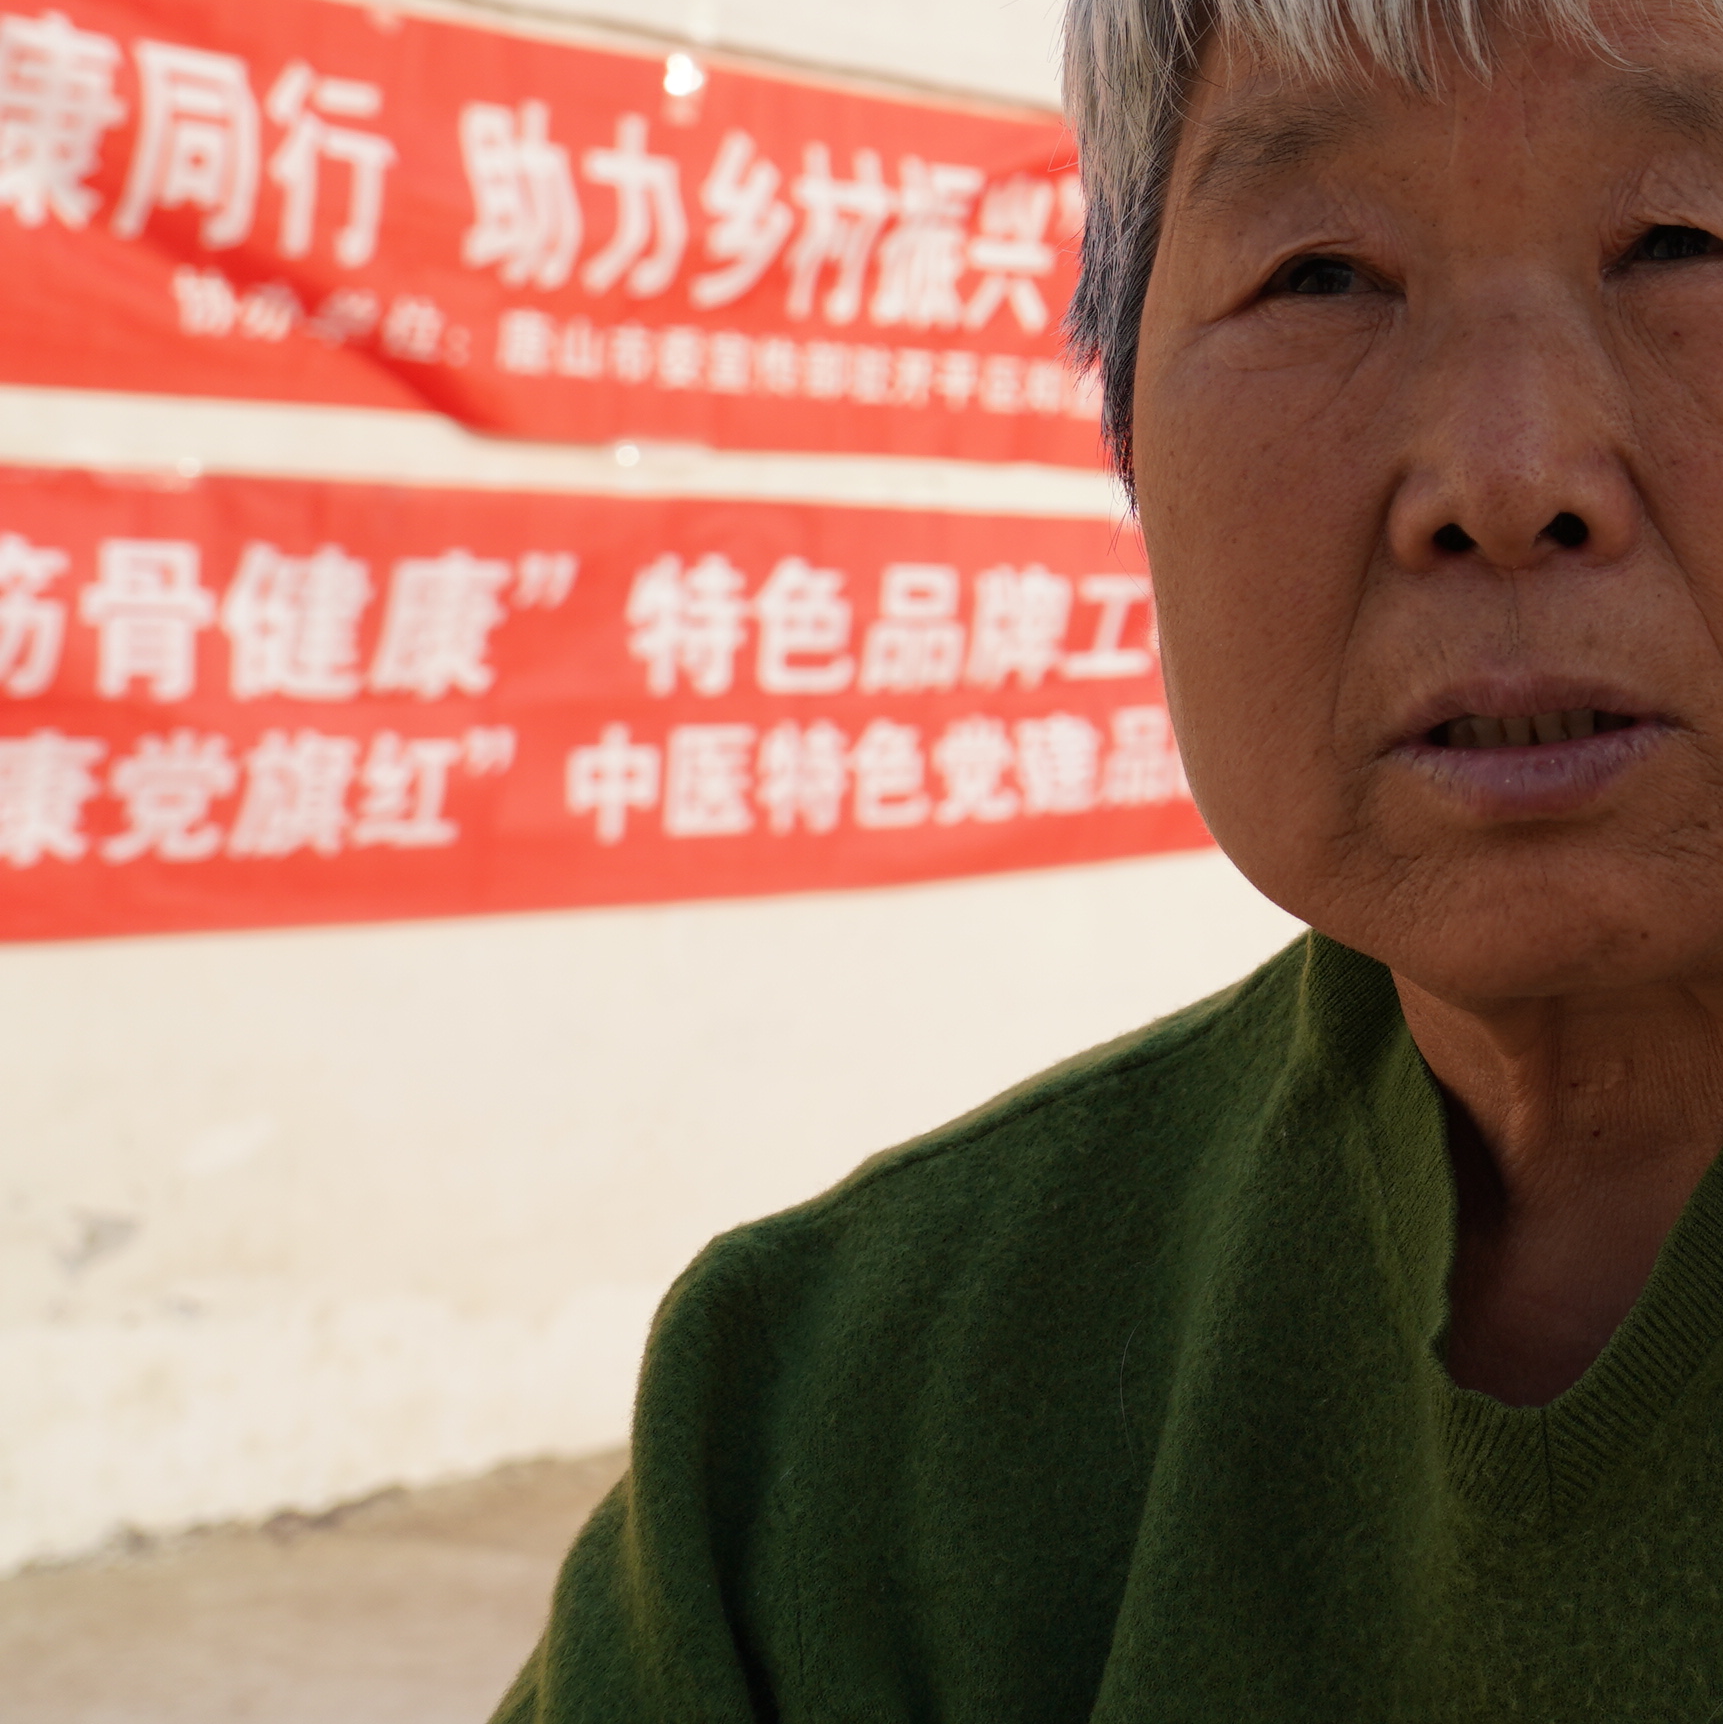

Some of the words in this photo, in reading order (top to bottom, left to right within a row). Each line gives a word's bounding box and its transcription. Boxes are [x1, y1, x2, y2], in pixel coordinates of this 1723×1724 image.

[0, 11, 397, 268] 康同行
[564, 703, 1192, 846] 中医特色党建品
